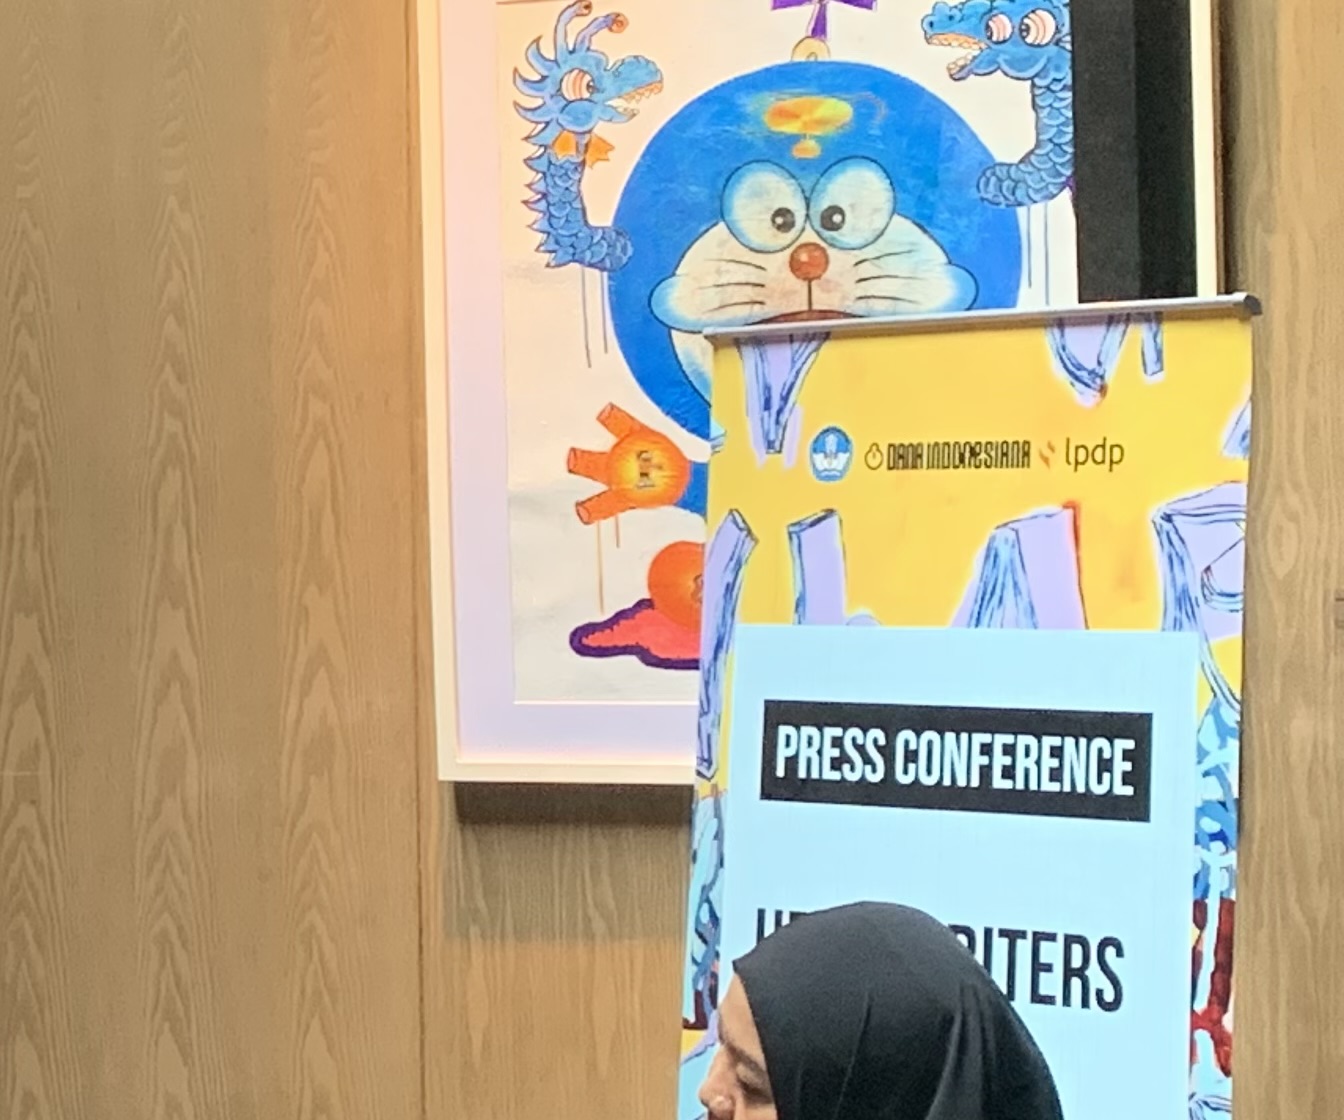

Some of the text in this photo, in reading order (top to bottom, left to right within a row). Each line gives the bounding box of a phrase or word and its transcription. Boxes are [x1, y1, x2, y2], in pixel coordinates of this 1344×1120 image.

[1065, 436, 1125, 473] lpdp
[775, 724, 1135, 796] PRESS CONFERENCE
